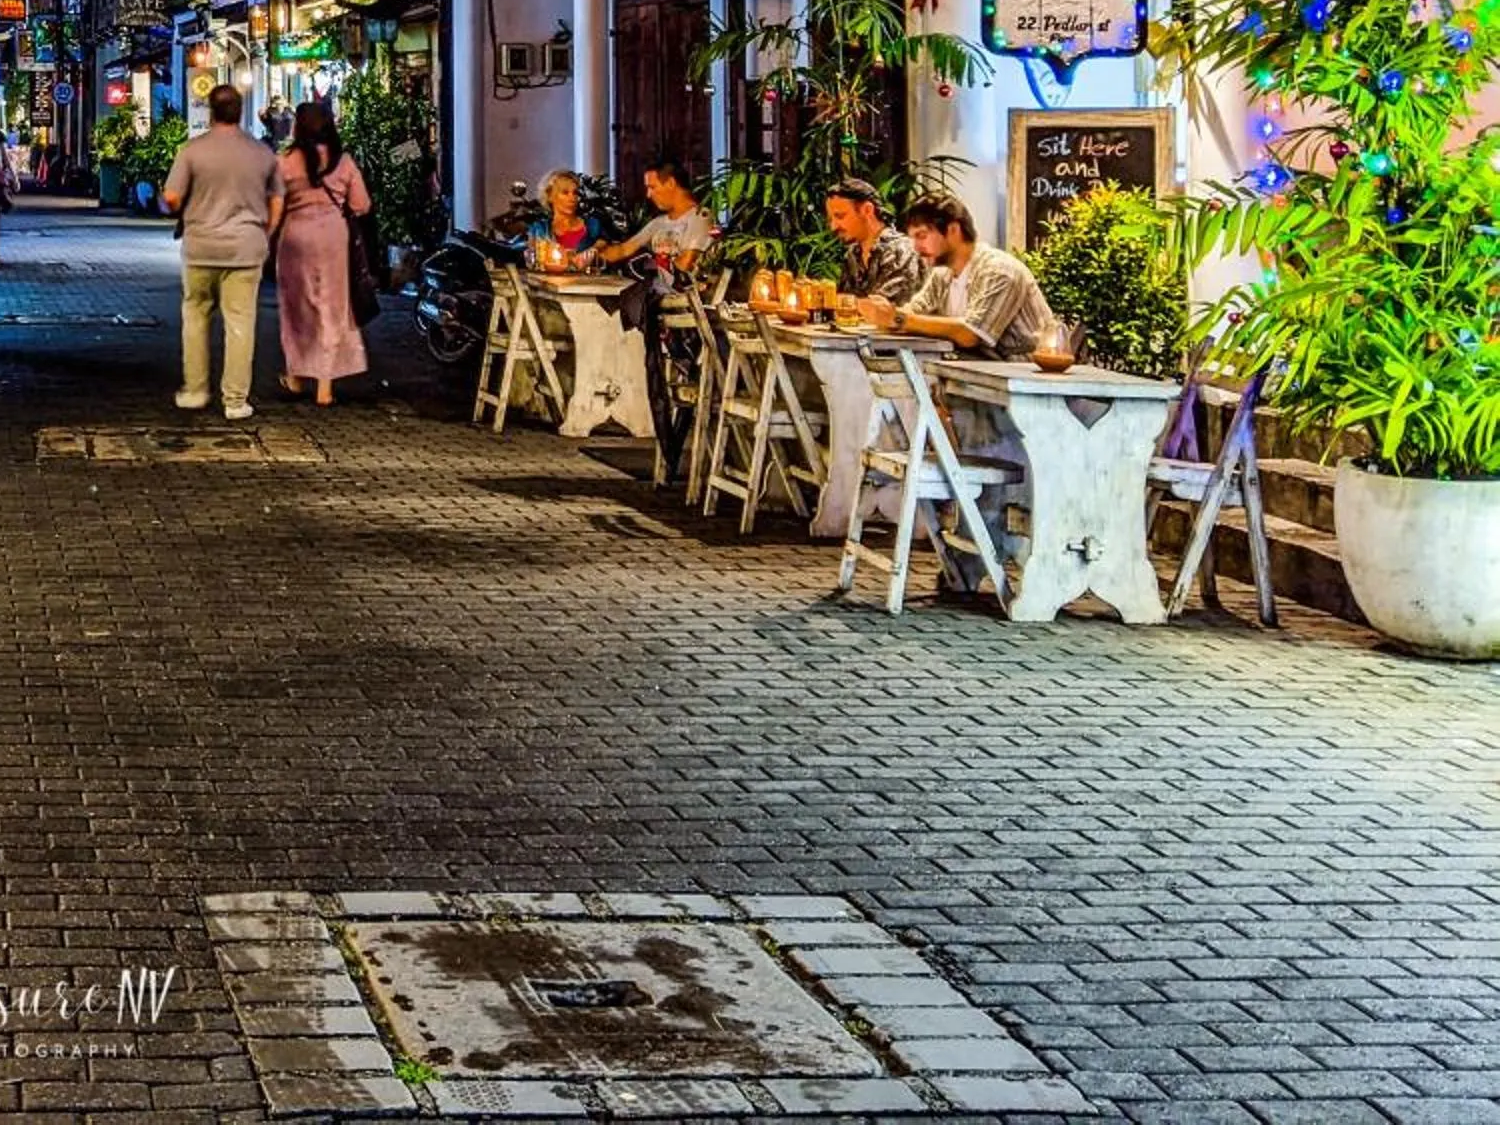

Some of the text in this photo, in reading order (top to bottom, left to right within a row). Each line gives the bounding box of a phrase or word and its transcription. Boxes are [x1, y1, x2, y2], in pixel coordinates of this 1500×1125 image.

[1079, 134, 1130, 157] Here
[1055, 158, 1100, 178] and
[1031, 178, 1081, 198] Drink
